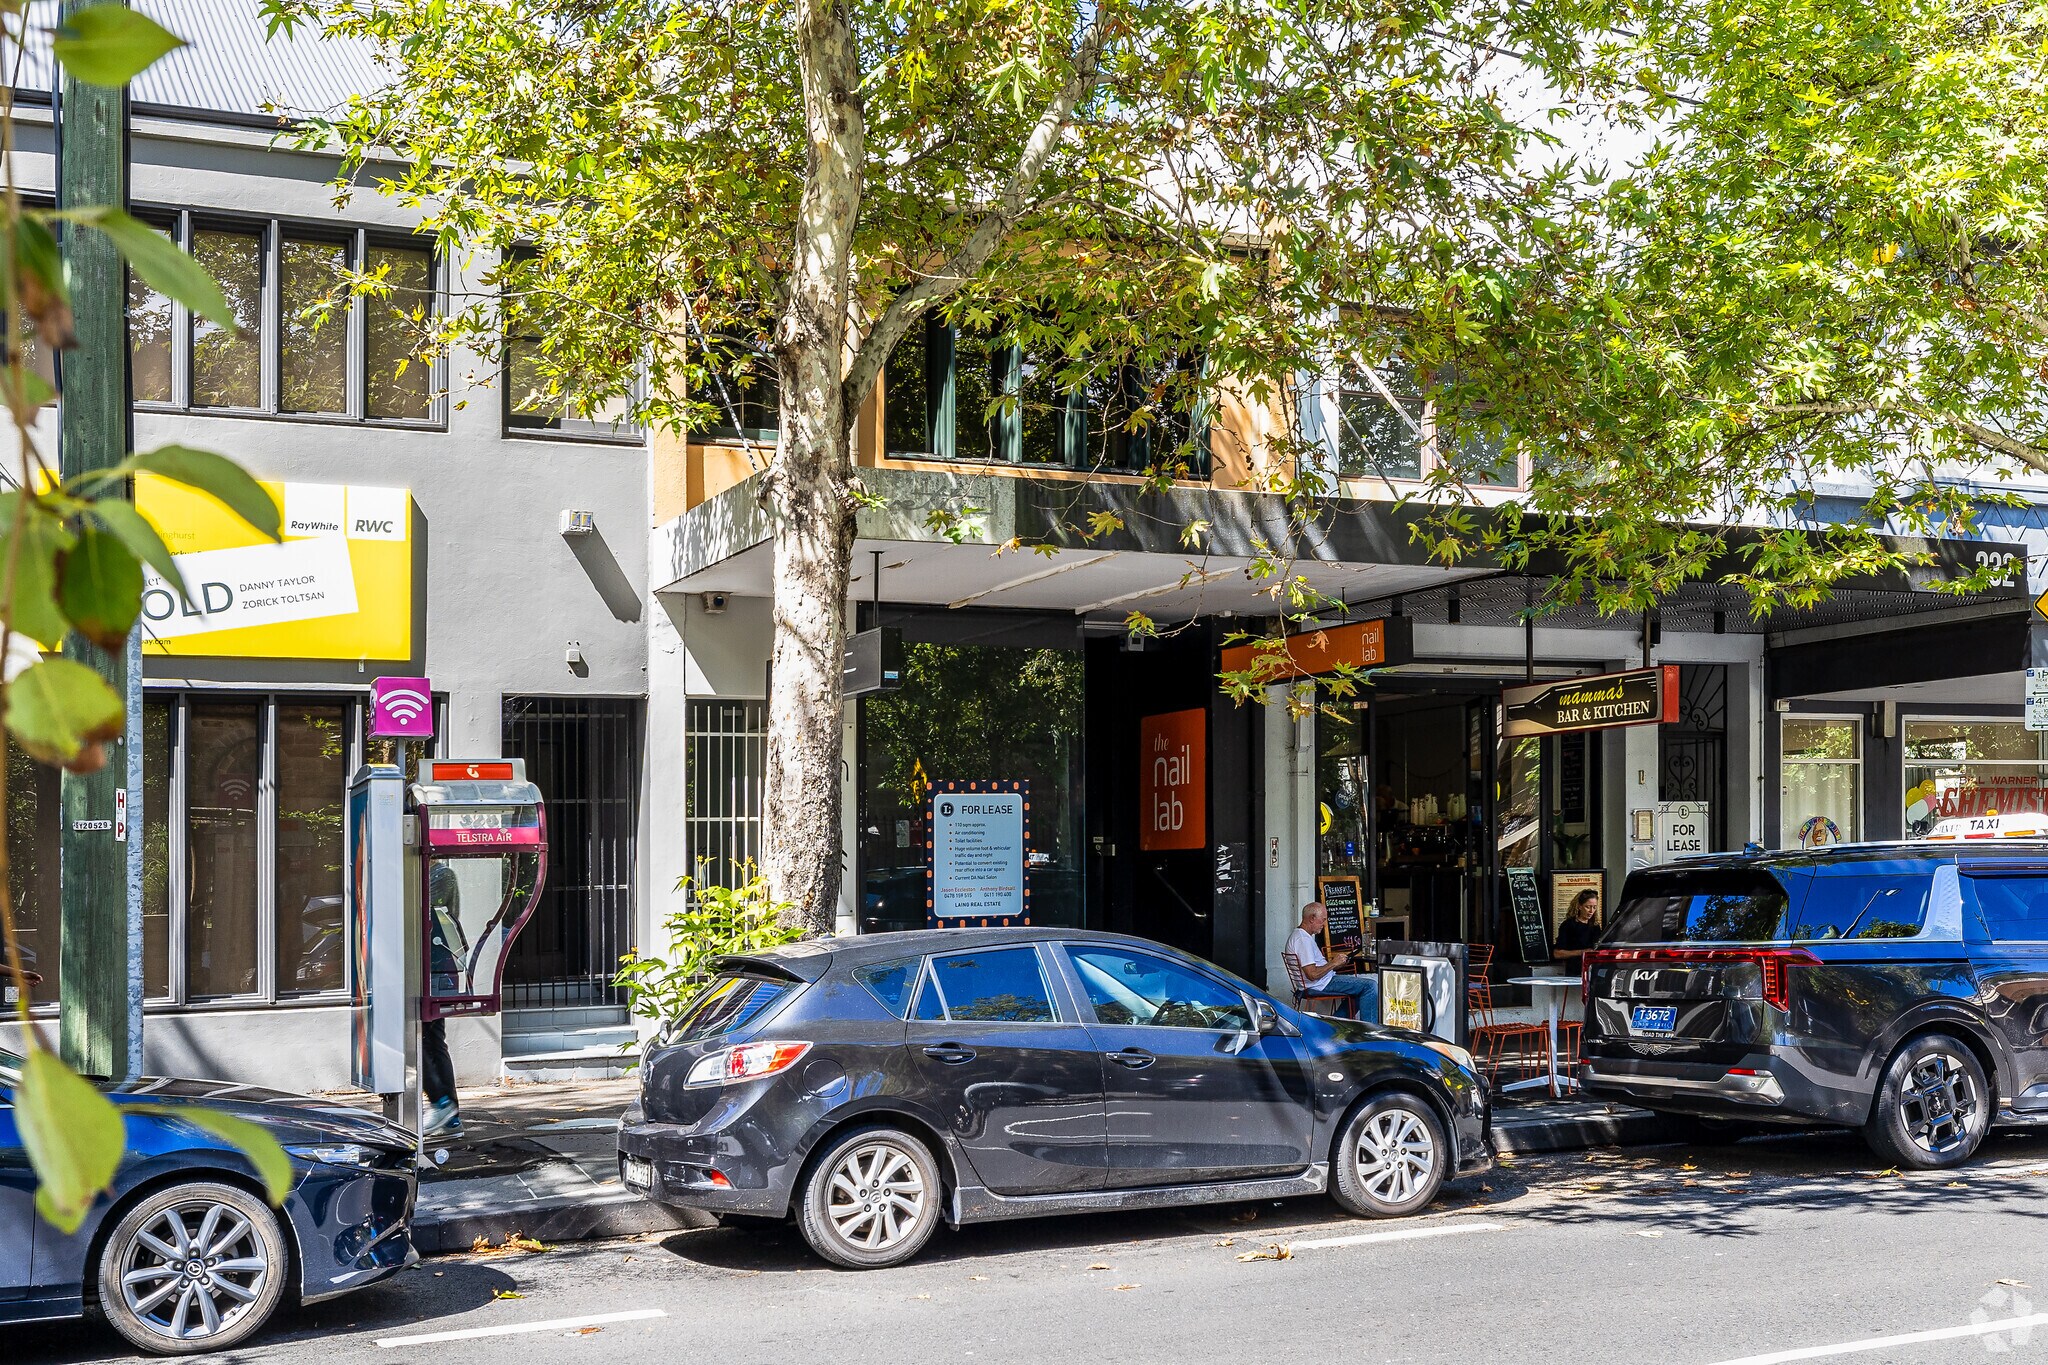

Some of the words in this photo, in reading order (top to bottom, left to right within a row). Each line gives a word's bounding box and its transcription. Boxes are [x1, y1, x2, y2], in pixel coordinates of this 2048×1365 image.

[290, 520, 339, 532] RayWhite
[355, 519, 394, 534] RWC
[240, 580, 275, 592] DANNY
[278, 575, 316, 588] TAYLOR
[141, 582, 234, 620] OLD
[242, 597, 279, 610] ZORICK
[282, 592, 325, 605] TOLTSAN
[1362, 628, 1380, 645] nail
[1362, 646, 1377, 662] lab
[1558, 678, 1624, 706] mamma's
[1556, 708, 1580, 724] BAR
[1582, 708, 1591, 720] &
[1594, 700, 1650, 720] KITCHEN
[1154, 733, 1169, 752] the
[1154, 744, 1190, 788] nail
[1990, 776, 2038, 784] WARNER
[961, 805, 980, 815] FOR
[982, 804, 1013, 814] LEASE
[1154, 791, 1184, 831] lab
[1673, 824, 1695, 836] FOR
[1970, 818, 2000, 830] TAXI
[456, 833, 494, 843] TELSTRA
[1667, 840, 1700, 851] LEASE
